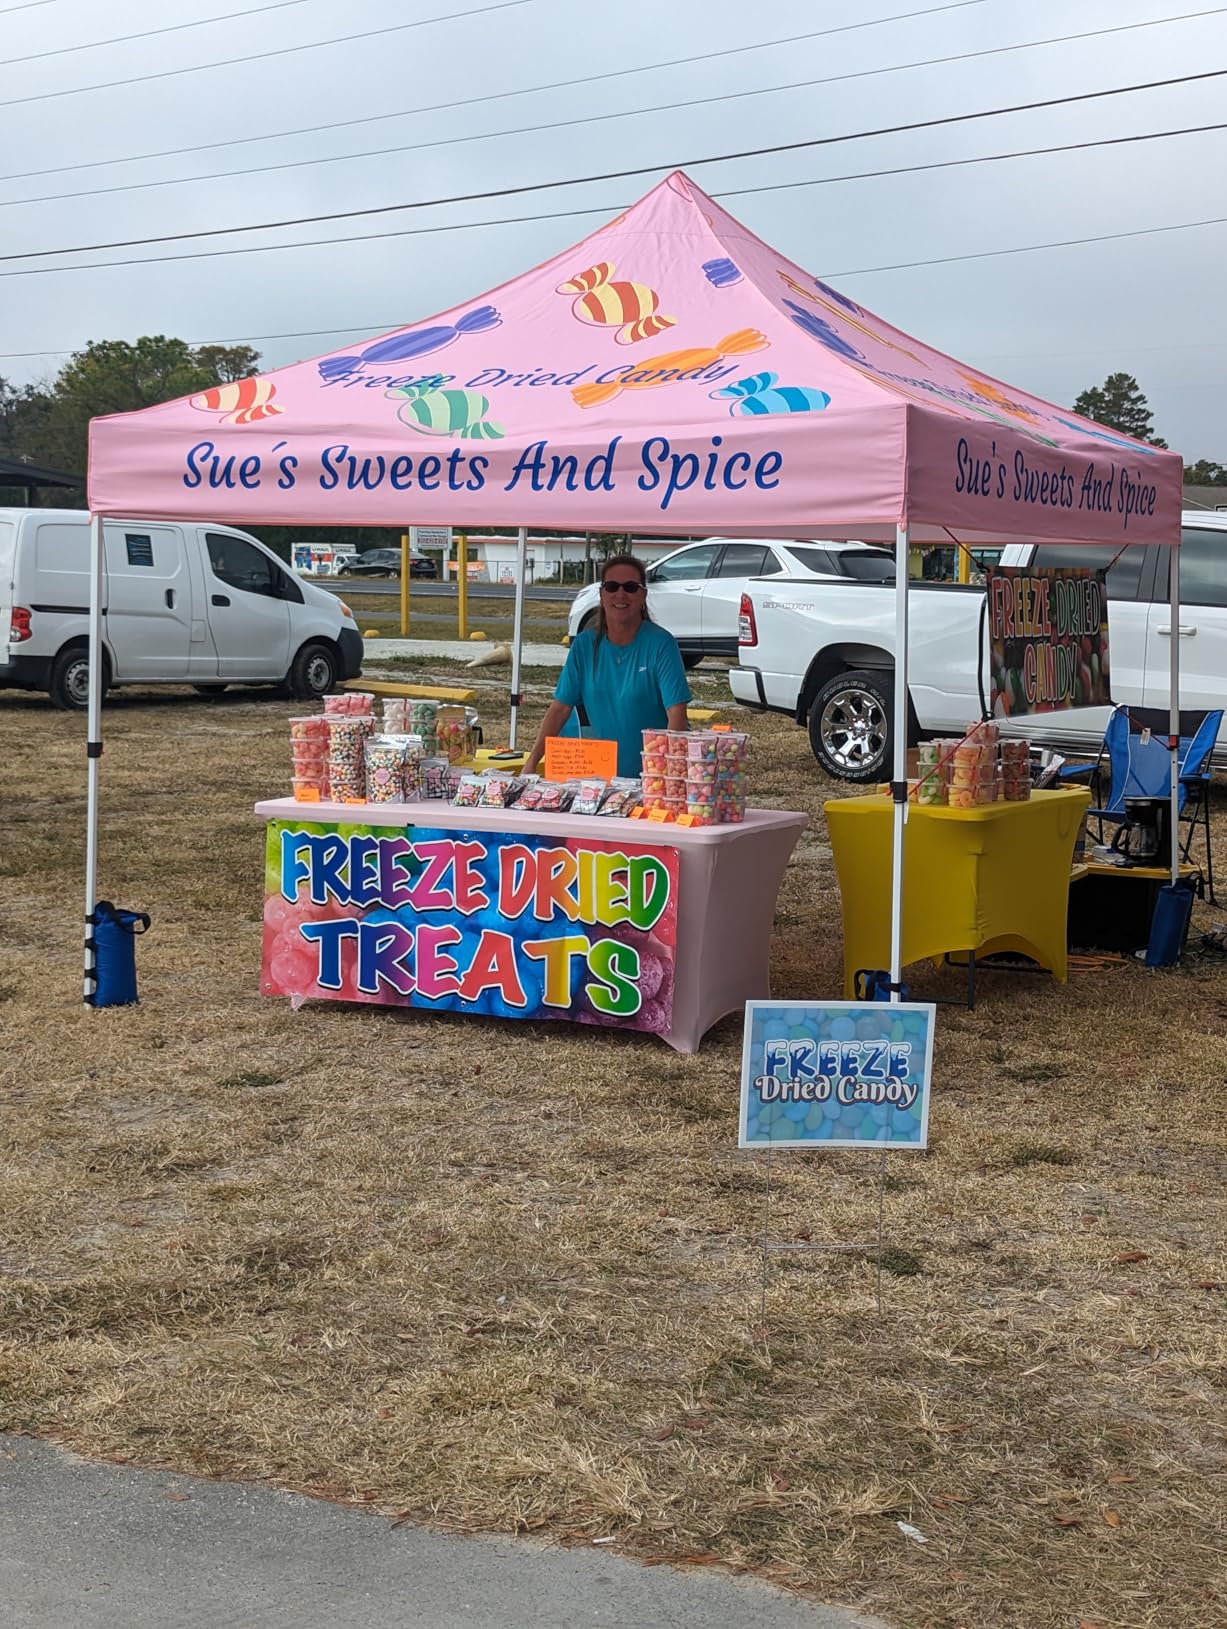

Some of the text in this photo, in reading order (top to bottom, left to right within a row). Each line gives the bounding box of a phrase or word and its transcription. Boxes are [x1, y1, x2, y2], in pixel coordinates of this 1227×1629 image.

[319, 358, 740, 389] Freeze Dried Candy
[318, 444, 490, 491] Sweets
[503, 434, 623, 492] And
[637, 435, 783, 511] Spice
[954, 437, 1158, 530] Sue's Sweets And Spice
[762, 600, 815, 611] SPORT
[991, 576, 1101, 640] FREEZE DRIED
[1023, 641, 1078, 704] CANDY
[279, 829, 671, 932] FREEZE DRIED
[299, 917, 643, 1018] TREATS
[763, 1038, 913, 1080] FREEZE
[754, 1074, 919, 1111] Dried Candy
